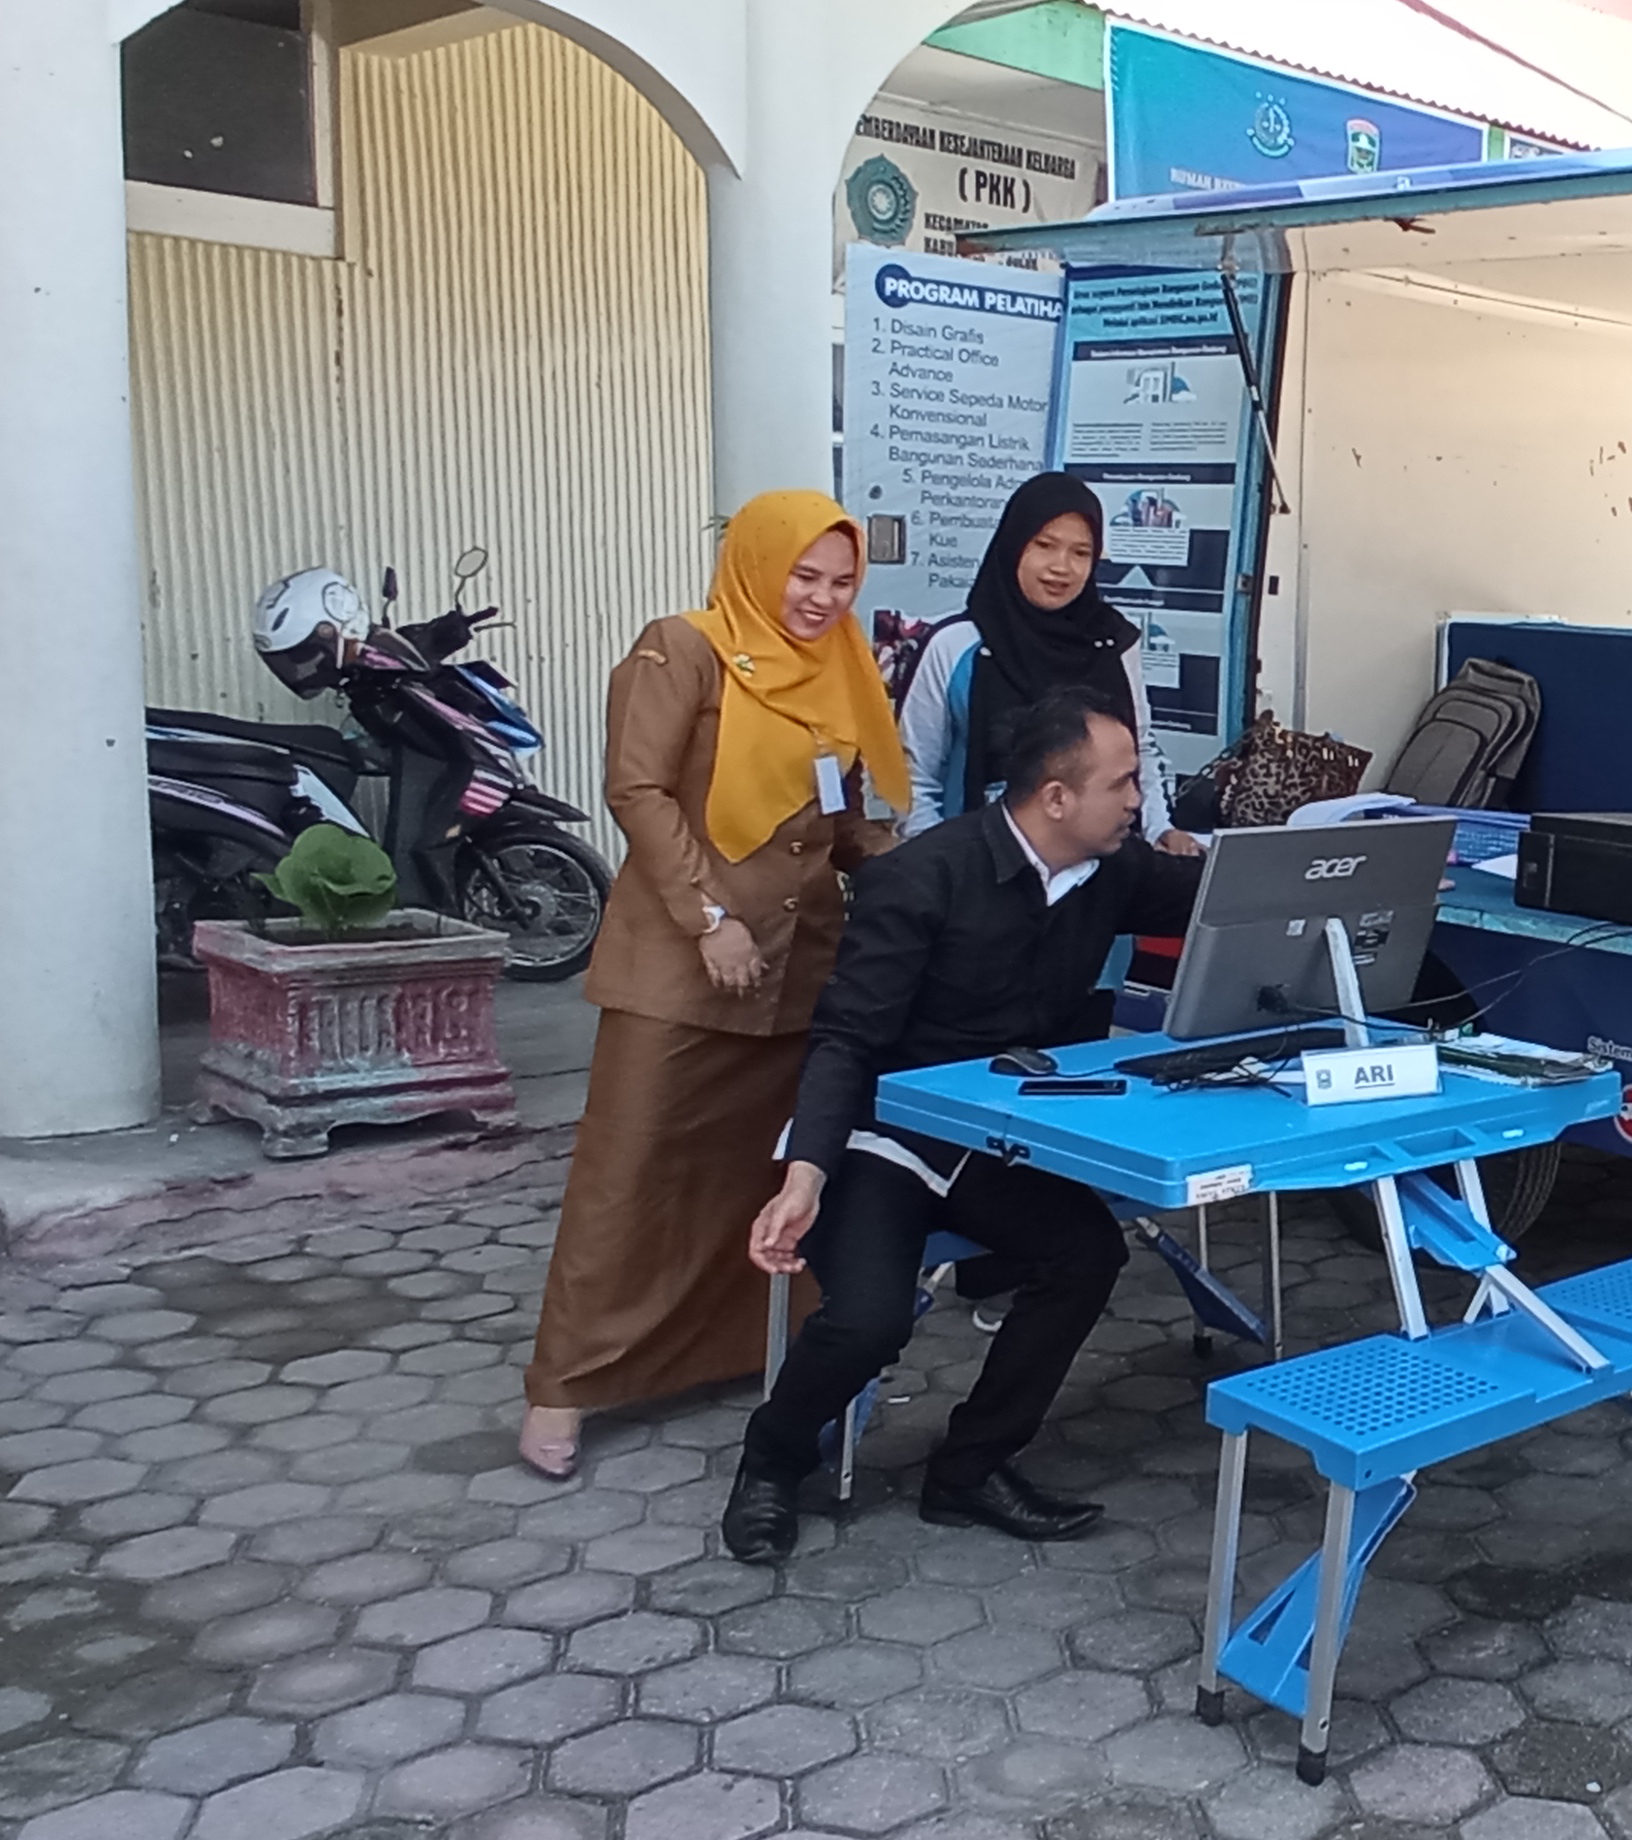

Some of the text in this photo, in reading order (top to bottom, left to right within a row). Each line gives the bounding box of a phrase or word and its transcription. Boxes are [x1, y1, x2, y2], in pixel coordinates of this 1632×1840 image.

[1025, 150, 1076, 180] KELUARGA
[884, 276, 980, 308] PROGRAM
[872, 317, 984, 345] 1. Disain Grafis
[871, 338, 999, 367] 2. Practical Office
[888, 362, 953, 382] Advance
[871, 381, 1048, 412] 3. Service Sepeda Motor
[888, 404, 987, 427] Konvensional
[870, 424, 1030, 451] 4. Pemasangan Listrik
[889, 446, 963, 467] Bangunan
[921, 469, 992, 489] Pengelola
[928, 532, 958, 548] Kue
[1304, 855, 1367, 880] acer
[1354, 1064, 1396, 1085] ARI
